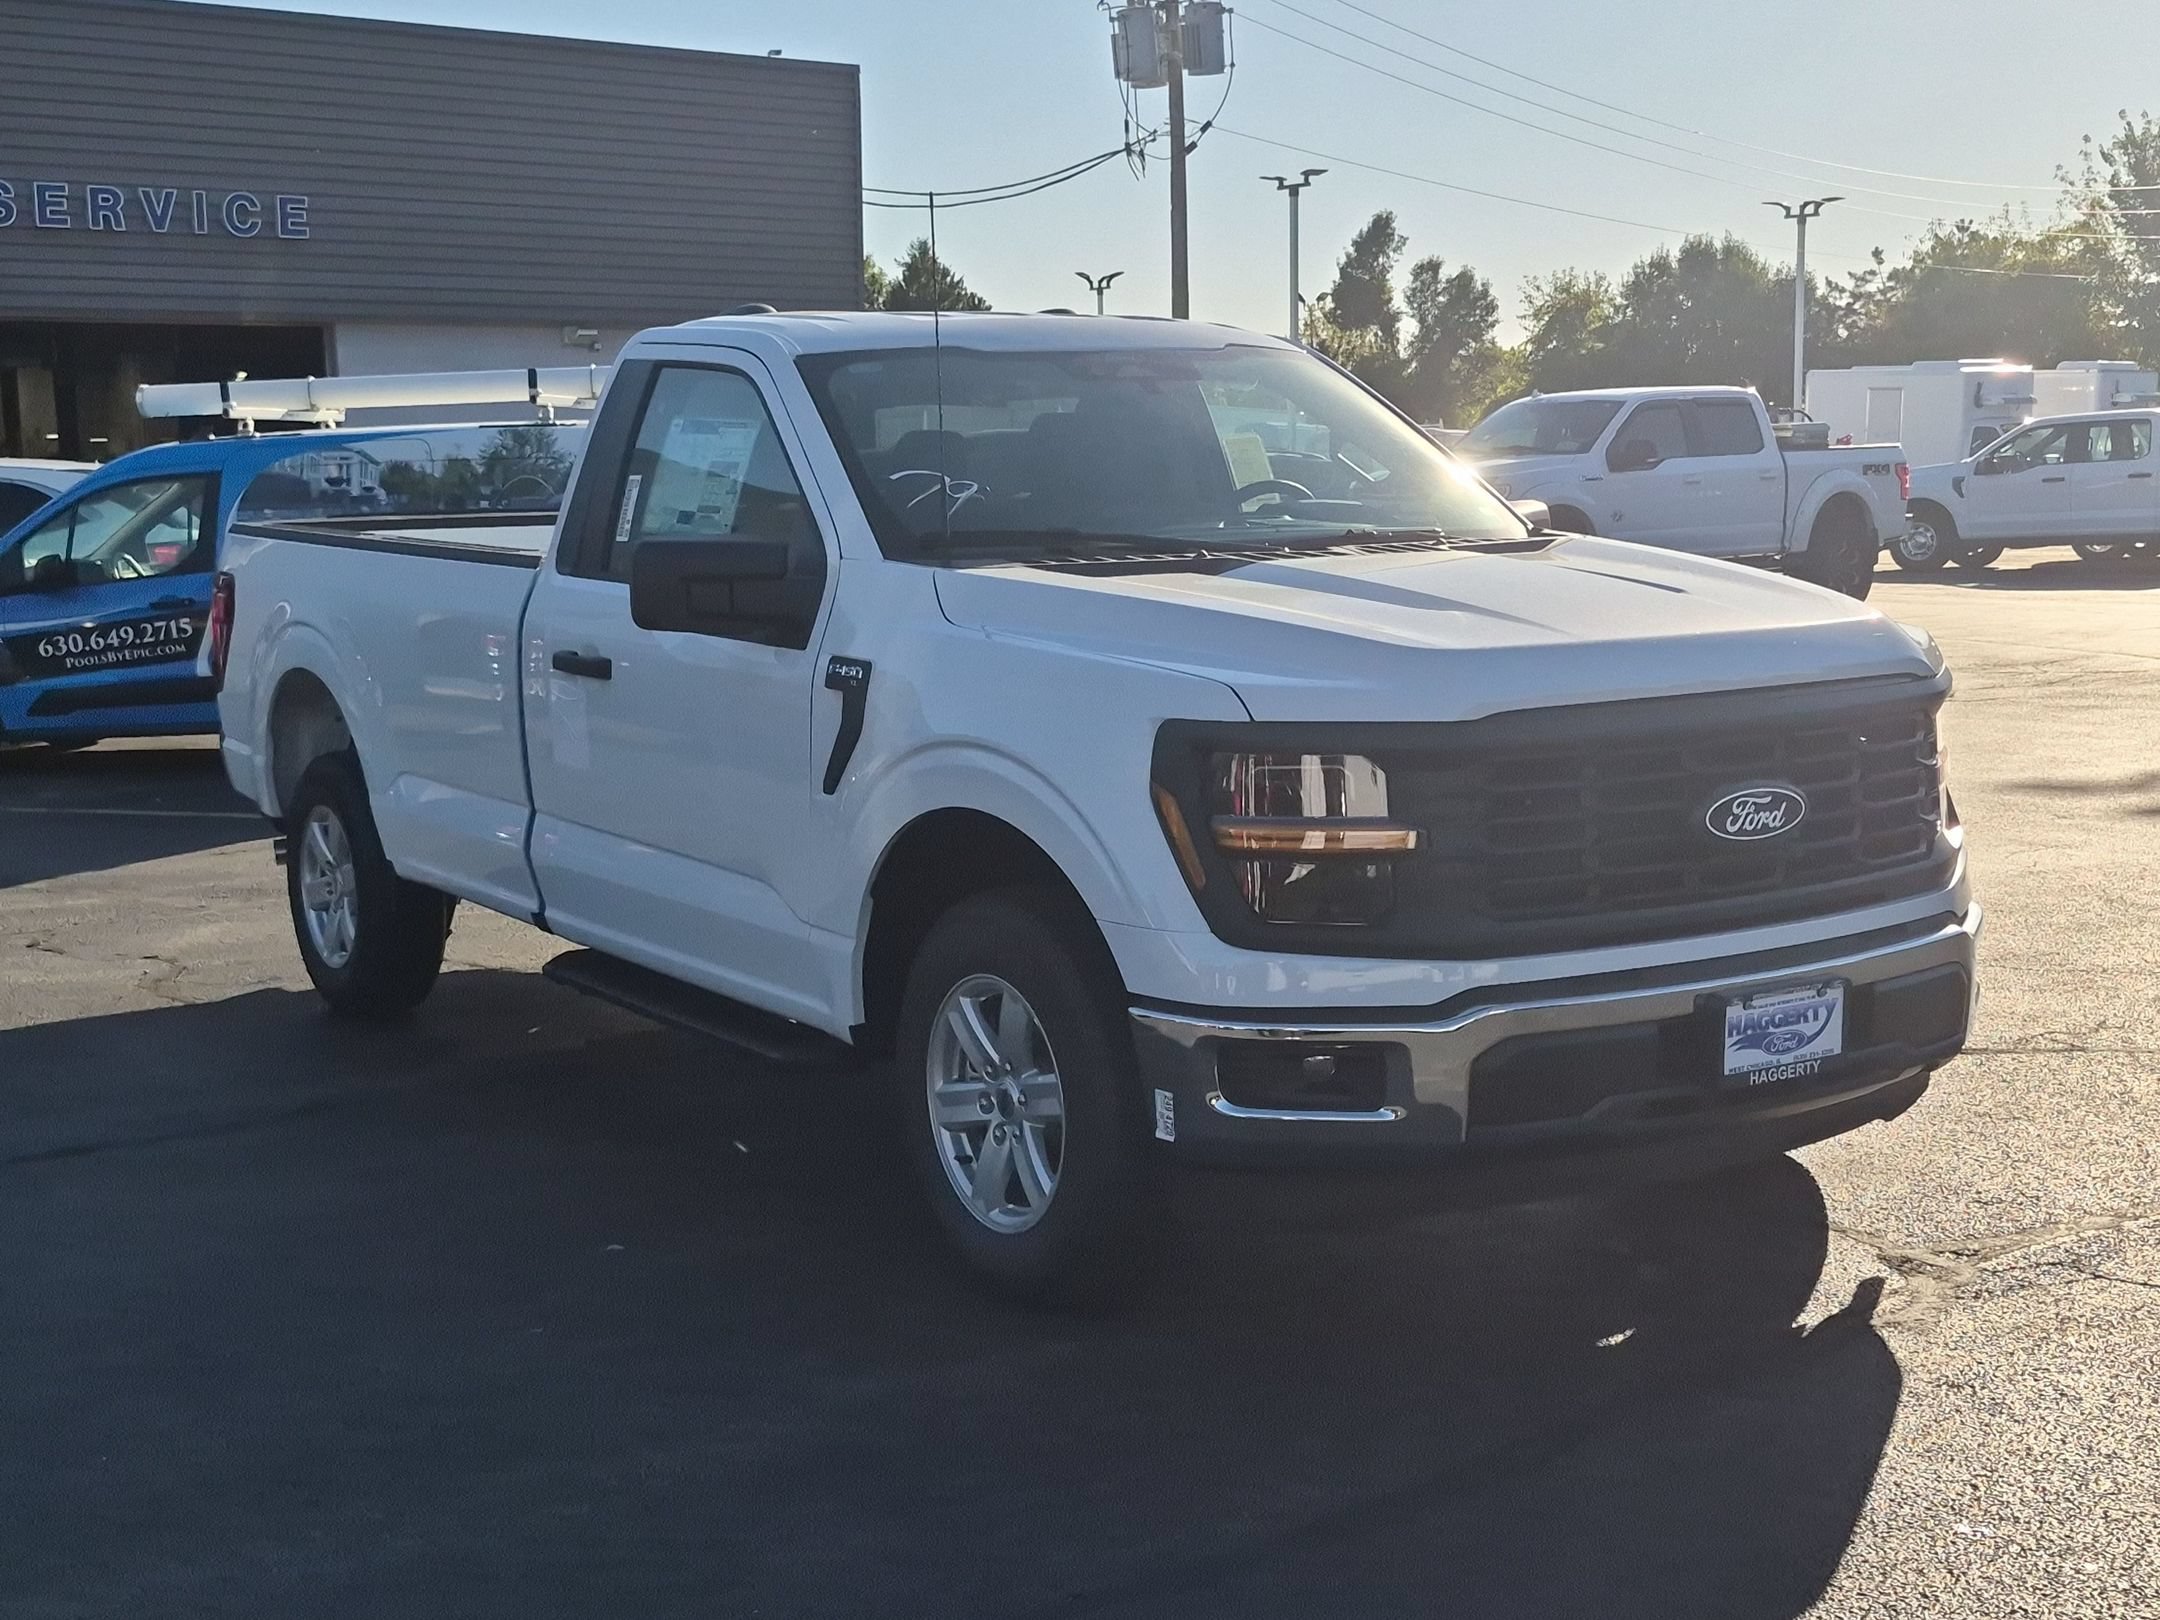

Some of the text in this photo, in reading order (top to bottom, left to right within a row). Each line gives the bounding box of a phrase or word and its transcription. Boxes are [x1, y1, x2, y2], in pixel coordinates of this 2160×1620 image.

[38, 617, 193, 657] 630.649.2715
[1726, 795, 1787, 832] Ford
[1727, 998, 1840, 1038] HAGGERTY
[1771, 1033, 1799, 1052] Ford
[1750, 1060, 1821, 1085] HAGGERTY
